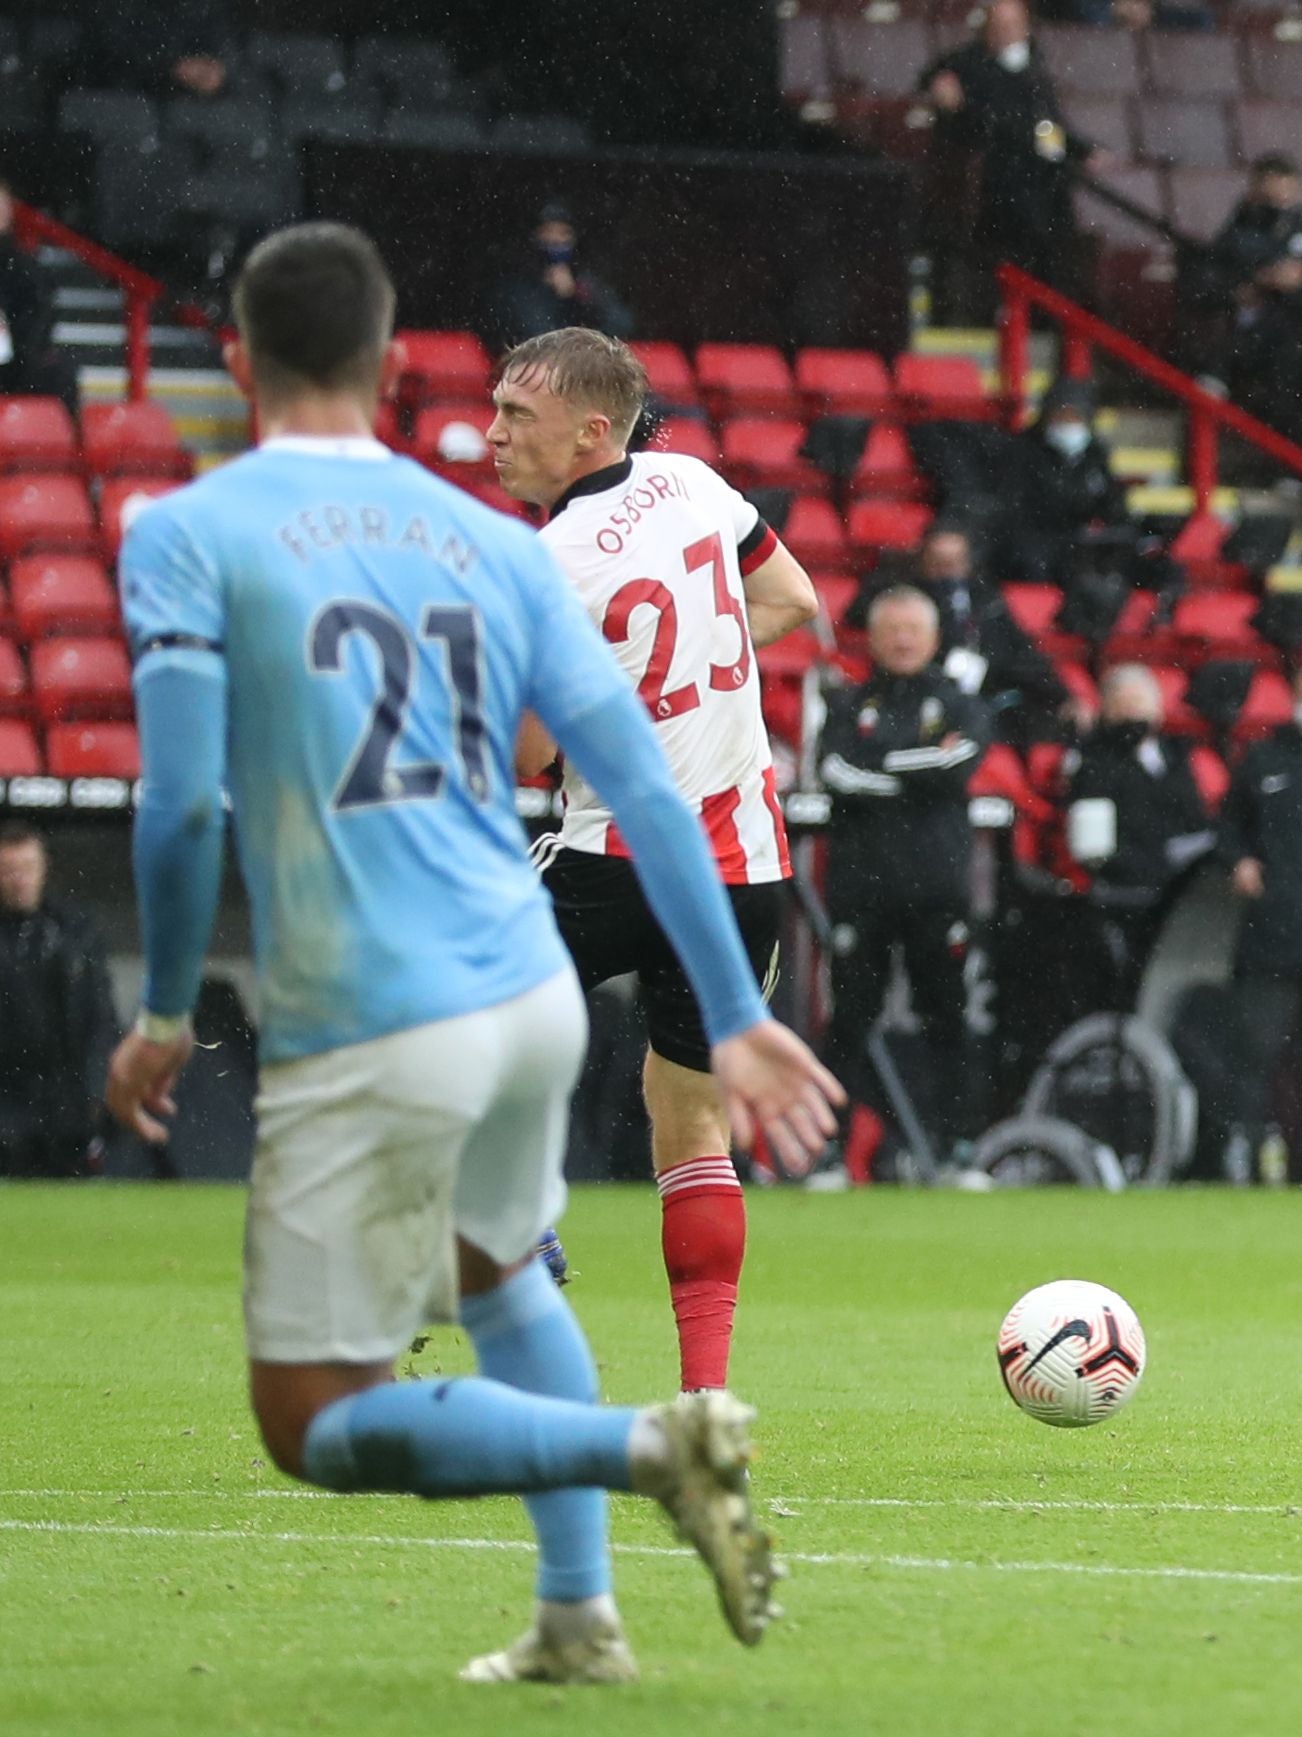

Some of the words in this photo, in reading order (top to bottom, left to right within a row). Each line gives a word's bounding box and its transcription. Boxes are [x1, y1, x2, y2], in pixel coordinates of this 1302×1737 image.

[278, 504, 482, 574] FERRAN
[602, 530, 750, 723] 23
[305, 599, 488, 811] 21
